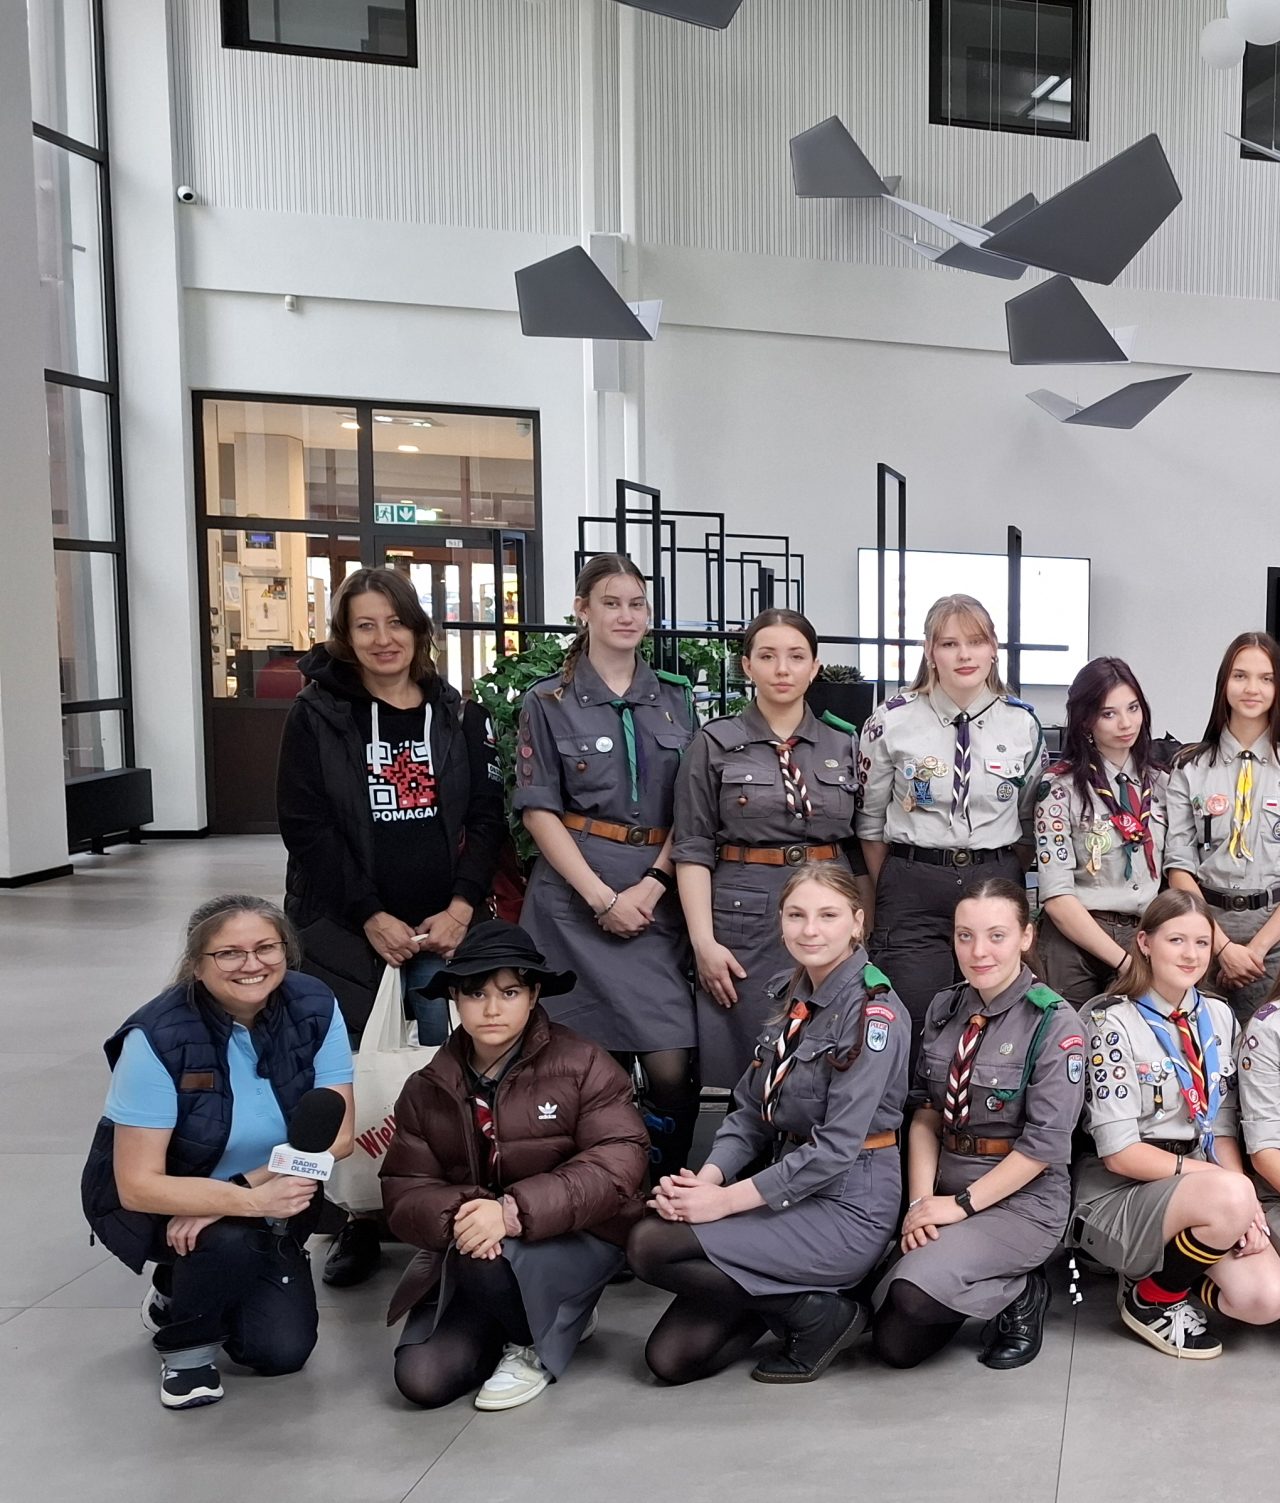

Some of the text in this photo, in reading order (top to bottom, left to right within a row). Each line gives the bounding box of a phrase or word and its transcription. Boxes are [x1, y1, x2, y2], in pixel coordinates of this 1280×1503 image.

[355, 1114, 397, 1159] Wiel
[292, 1159, 318, 1168] RADIO
[291, 1165, 328, 1176] OLSZTYN
